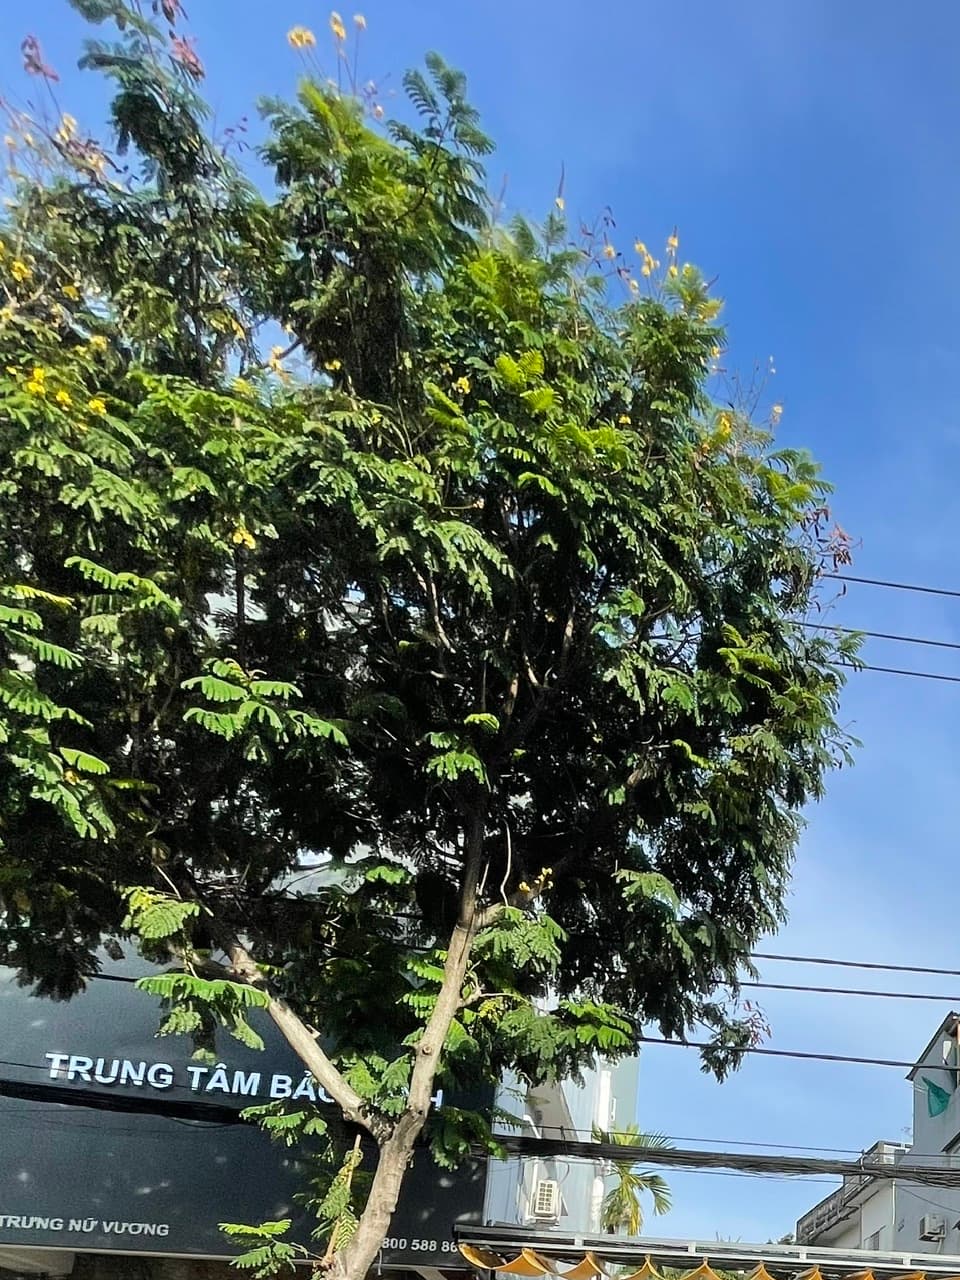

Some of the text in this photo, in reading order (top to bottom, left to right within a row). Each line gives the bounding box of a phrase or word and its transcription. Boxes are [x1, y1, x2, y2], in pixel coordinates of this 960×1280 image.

[46, 1053, 173, 1088] TRUNG
[188, 1063, 260, 1097] TÂM
[68, 1217, 98, 1233] NỮ
[102, 1220, 169, 1236] VƯƠNG
[411, 1240, 436, 1252] 588
